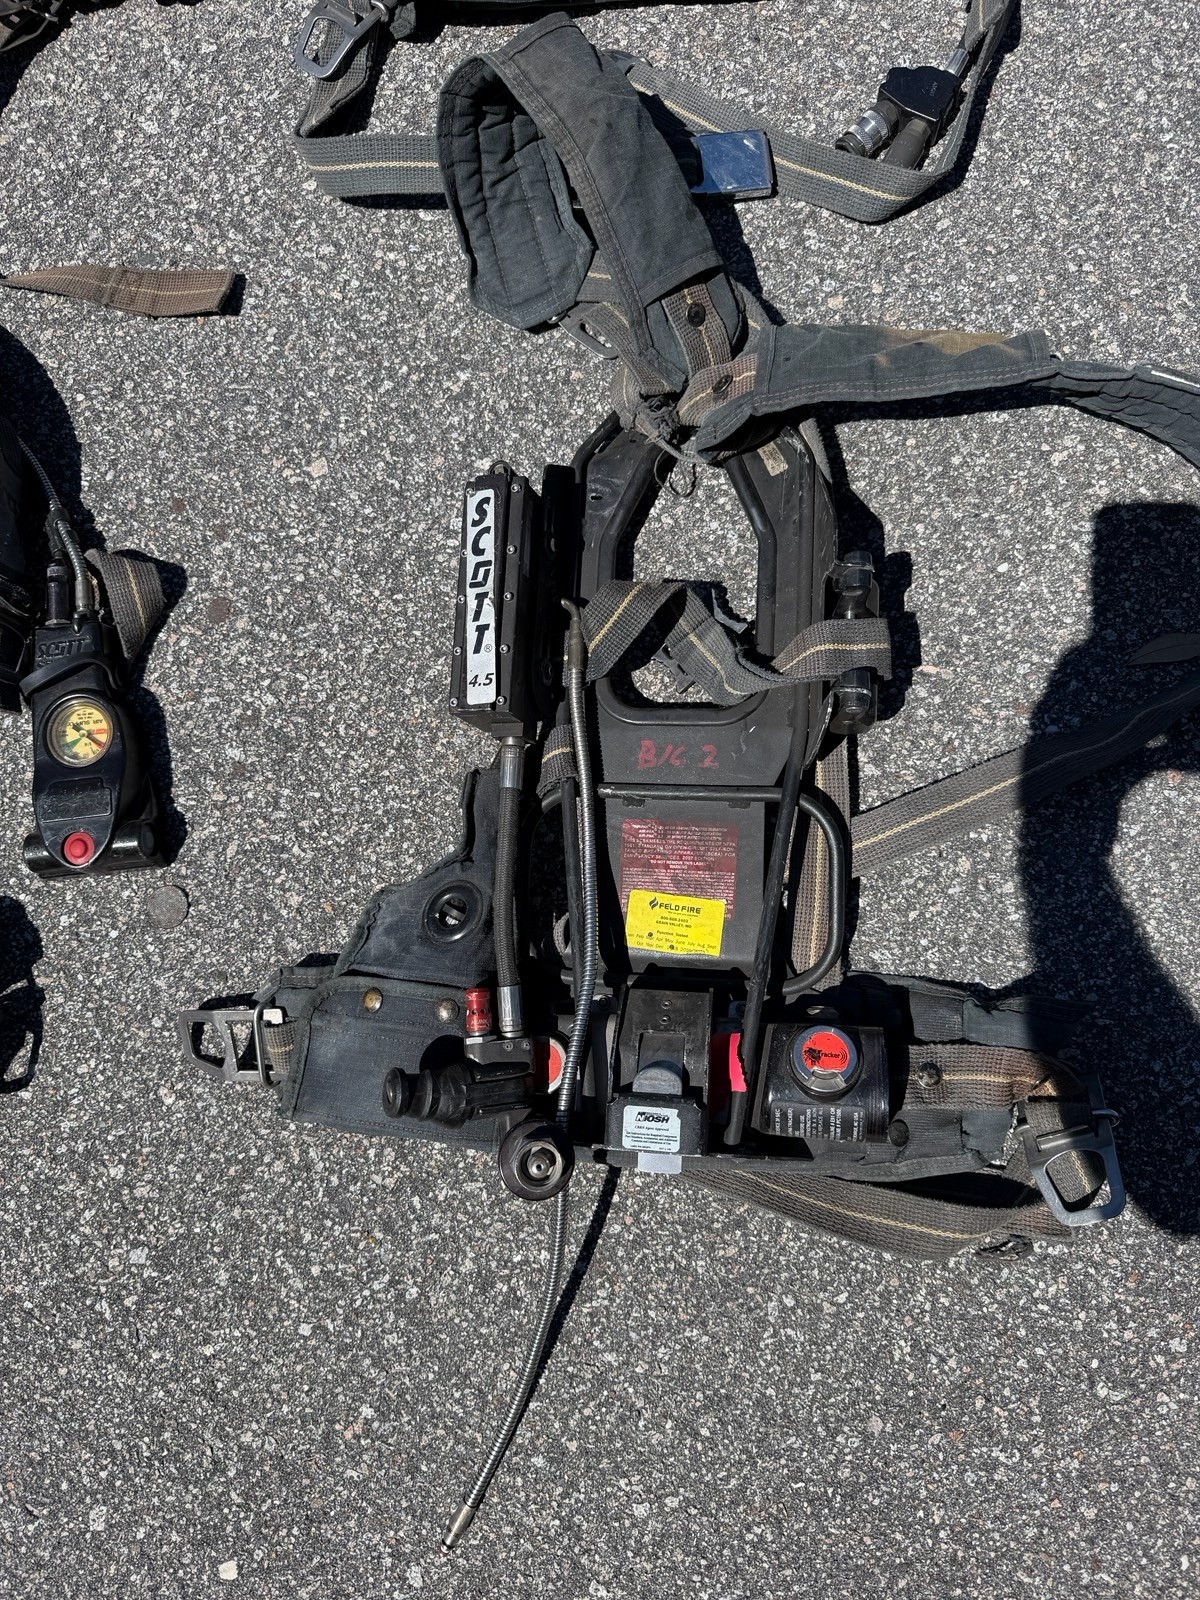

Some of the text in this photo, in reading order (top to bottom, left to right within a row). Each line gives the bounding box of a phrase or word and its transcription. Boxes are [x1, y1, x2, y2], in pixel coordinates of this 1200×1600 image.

[469, 673, 494, 687] 4.5
[700, 744, 719, 768] 2
[659, 902, 680, 911] FELD
[681, 905, 702, 914] FIRE
[635, 1112, 669, 1123] NIOSH
